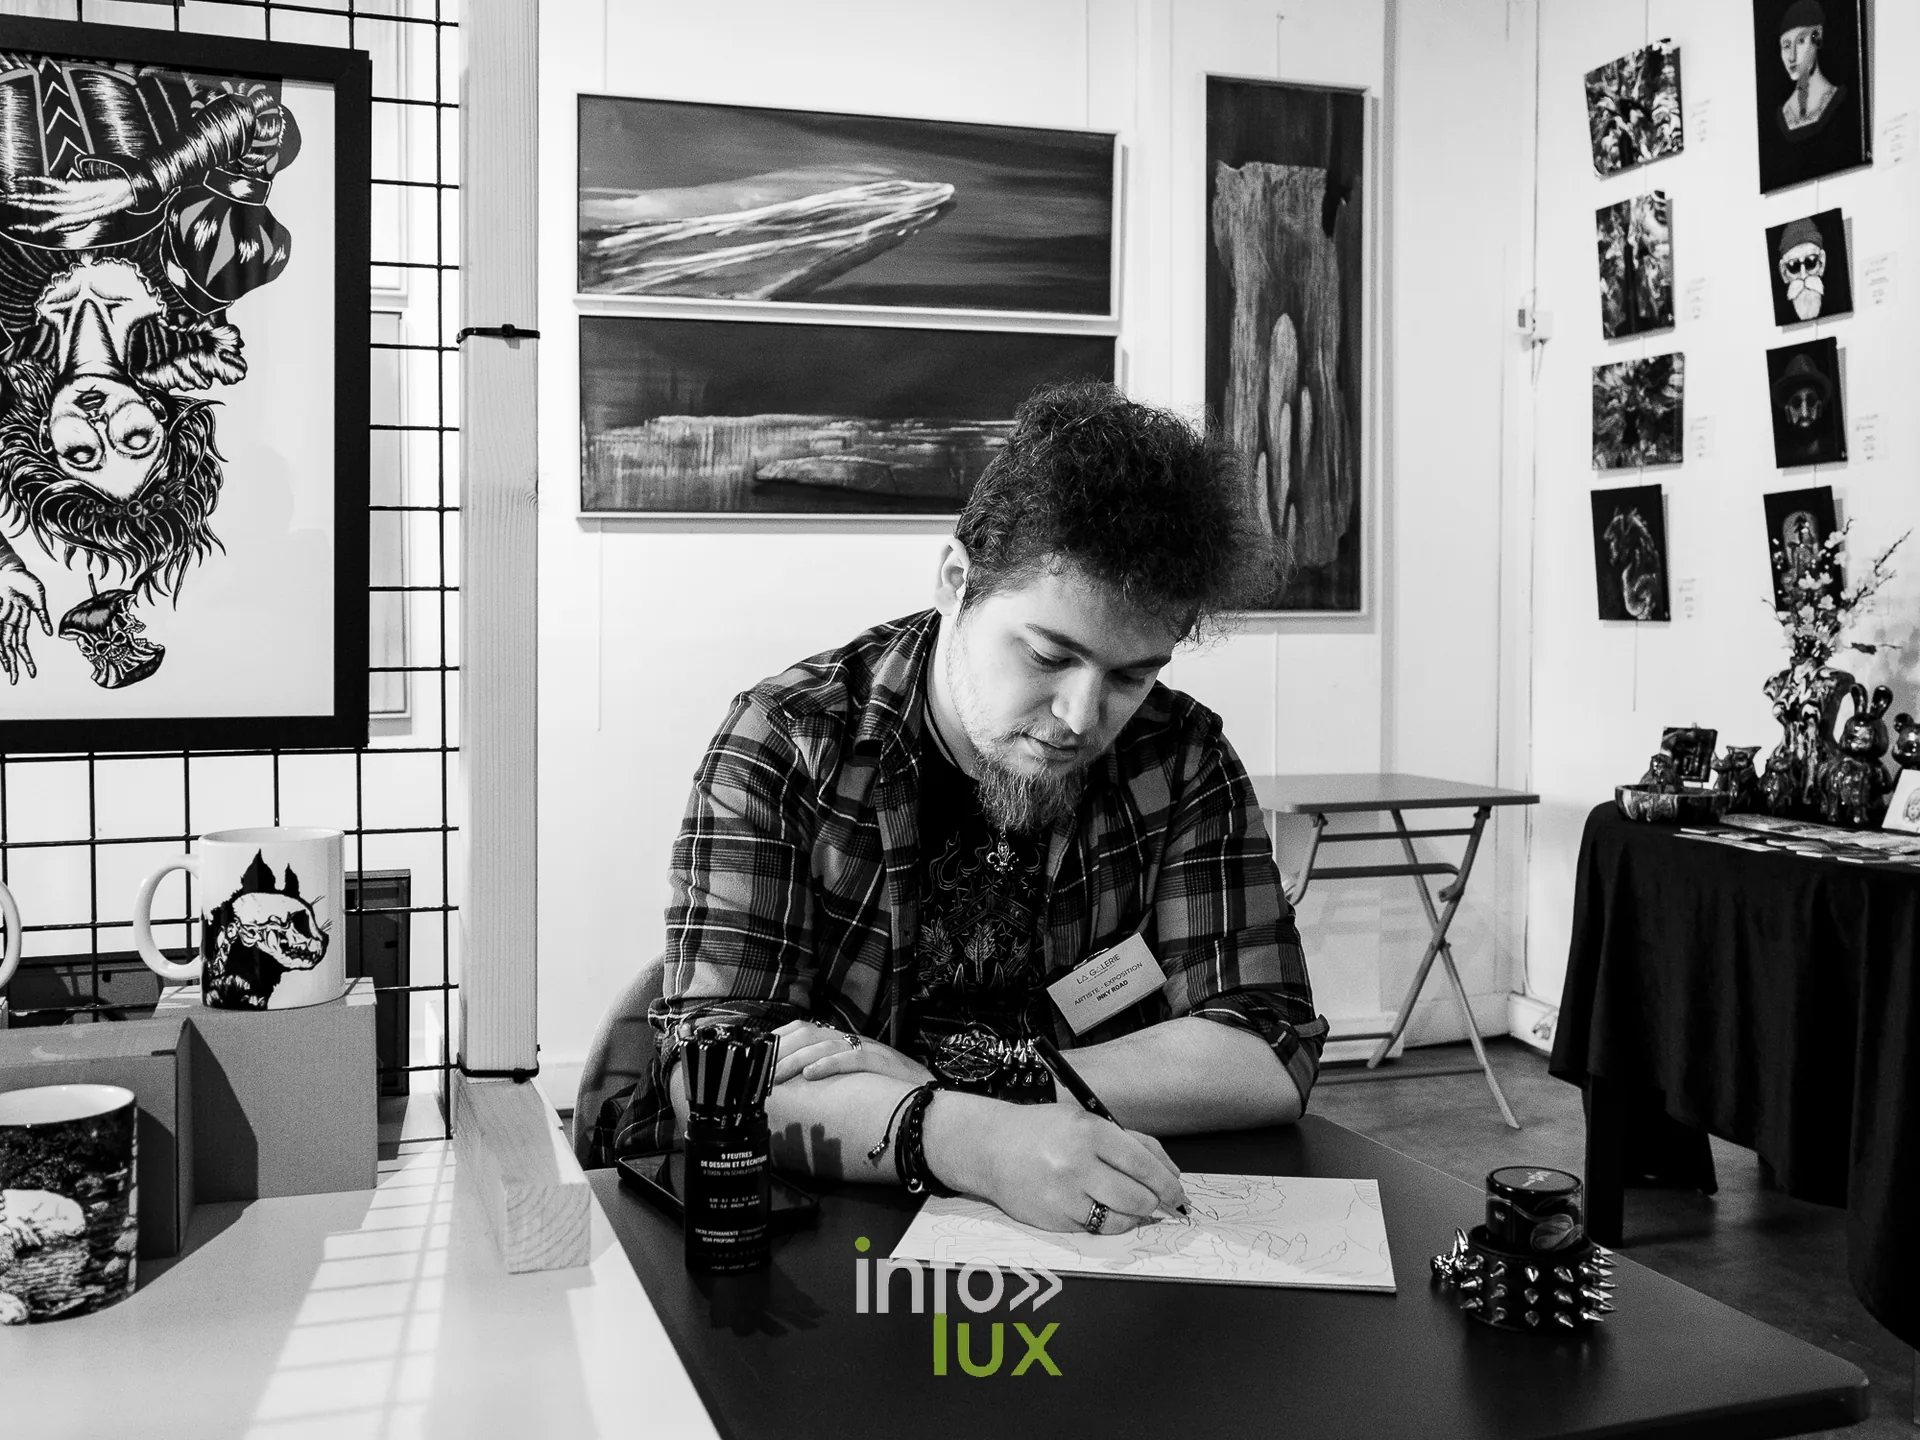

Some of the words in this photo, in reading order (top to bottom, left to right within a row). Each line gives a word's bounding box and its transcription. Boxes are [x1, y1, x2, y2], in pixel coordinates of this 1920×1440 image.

[1076, 974, 1089, 985] LA
[1089, 953, 1121, 977] GALERIE
[1074, 987, 1099, 1006] ARTISTE
[1103, 962, 1143, 987] EXPOSITION
[1096, 989, 1111, 1002] INKY
[1111, 979, 1129, 993] ROAD
[700, 1160, 708, 1168] DE
[709, 1160, 731, 1169] DESSIN
[732, 1160, 740, 1168] ET
[727, 1150, 753, 1160] FEUTRES
